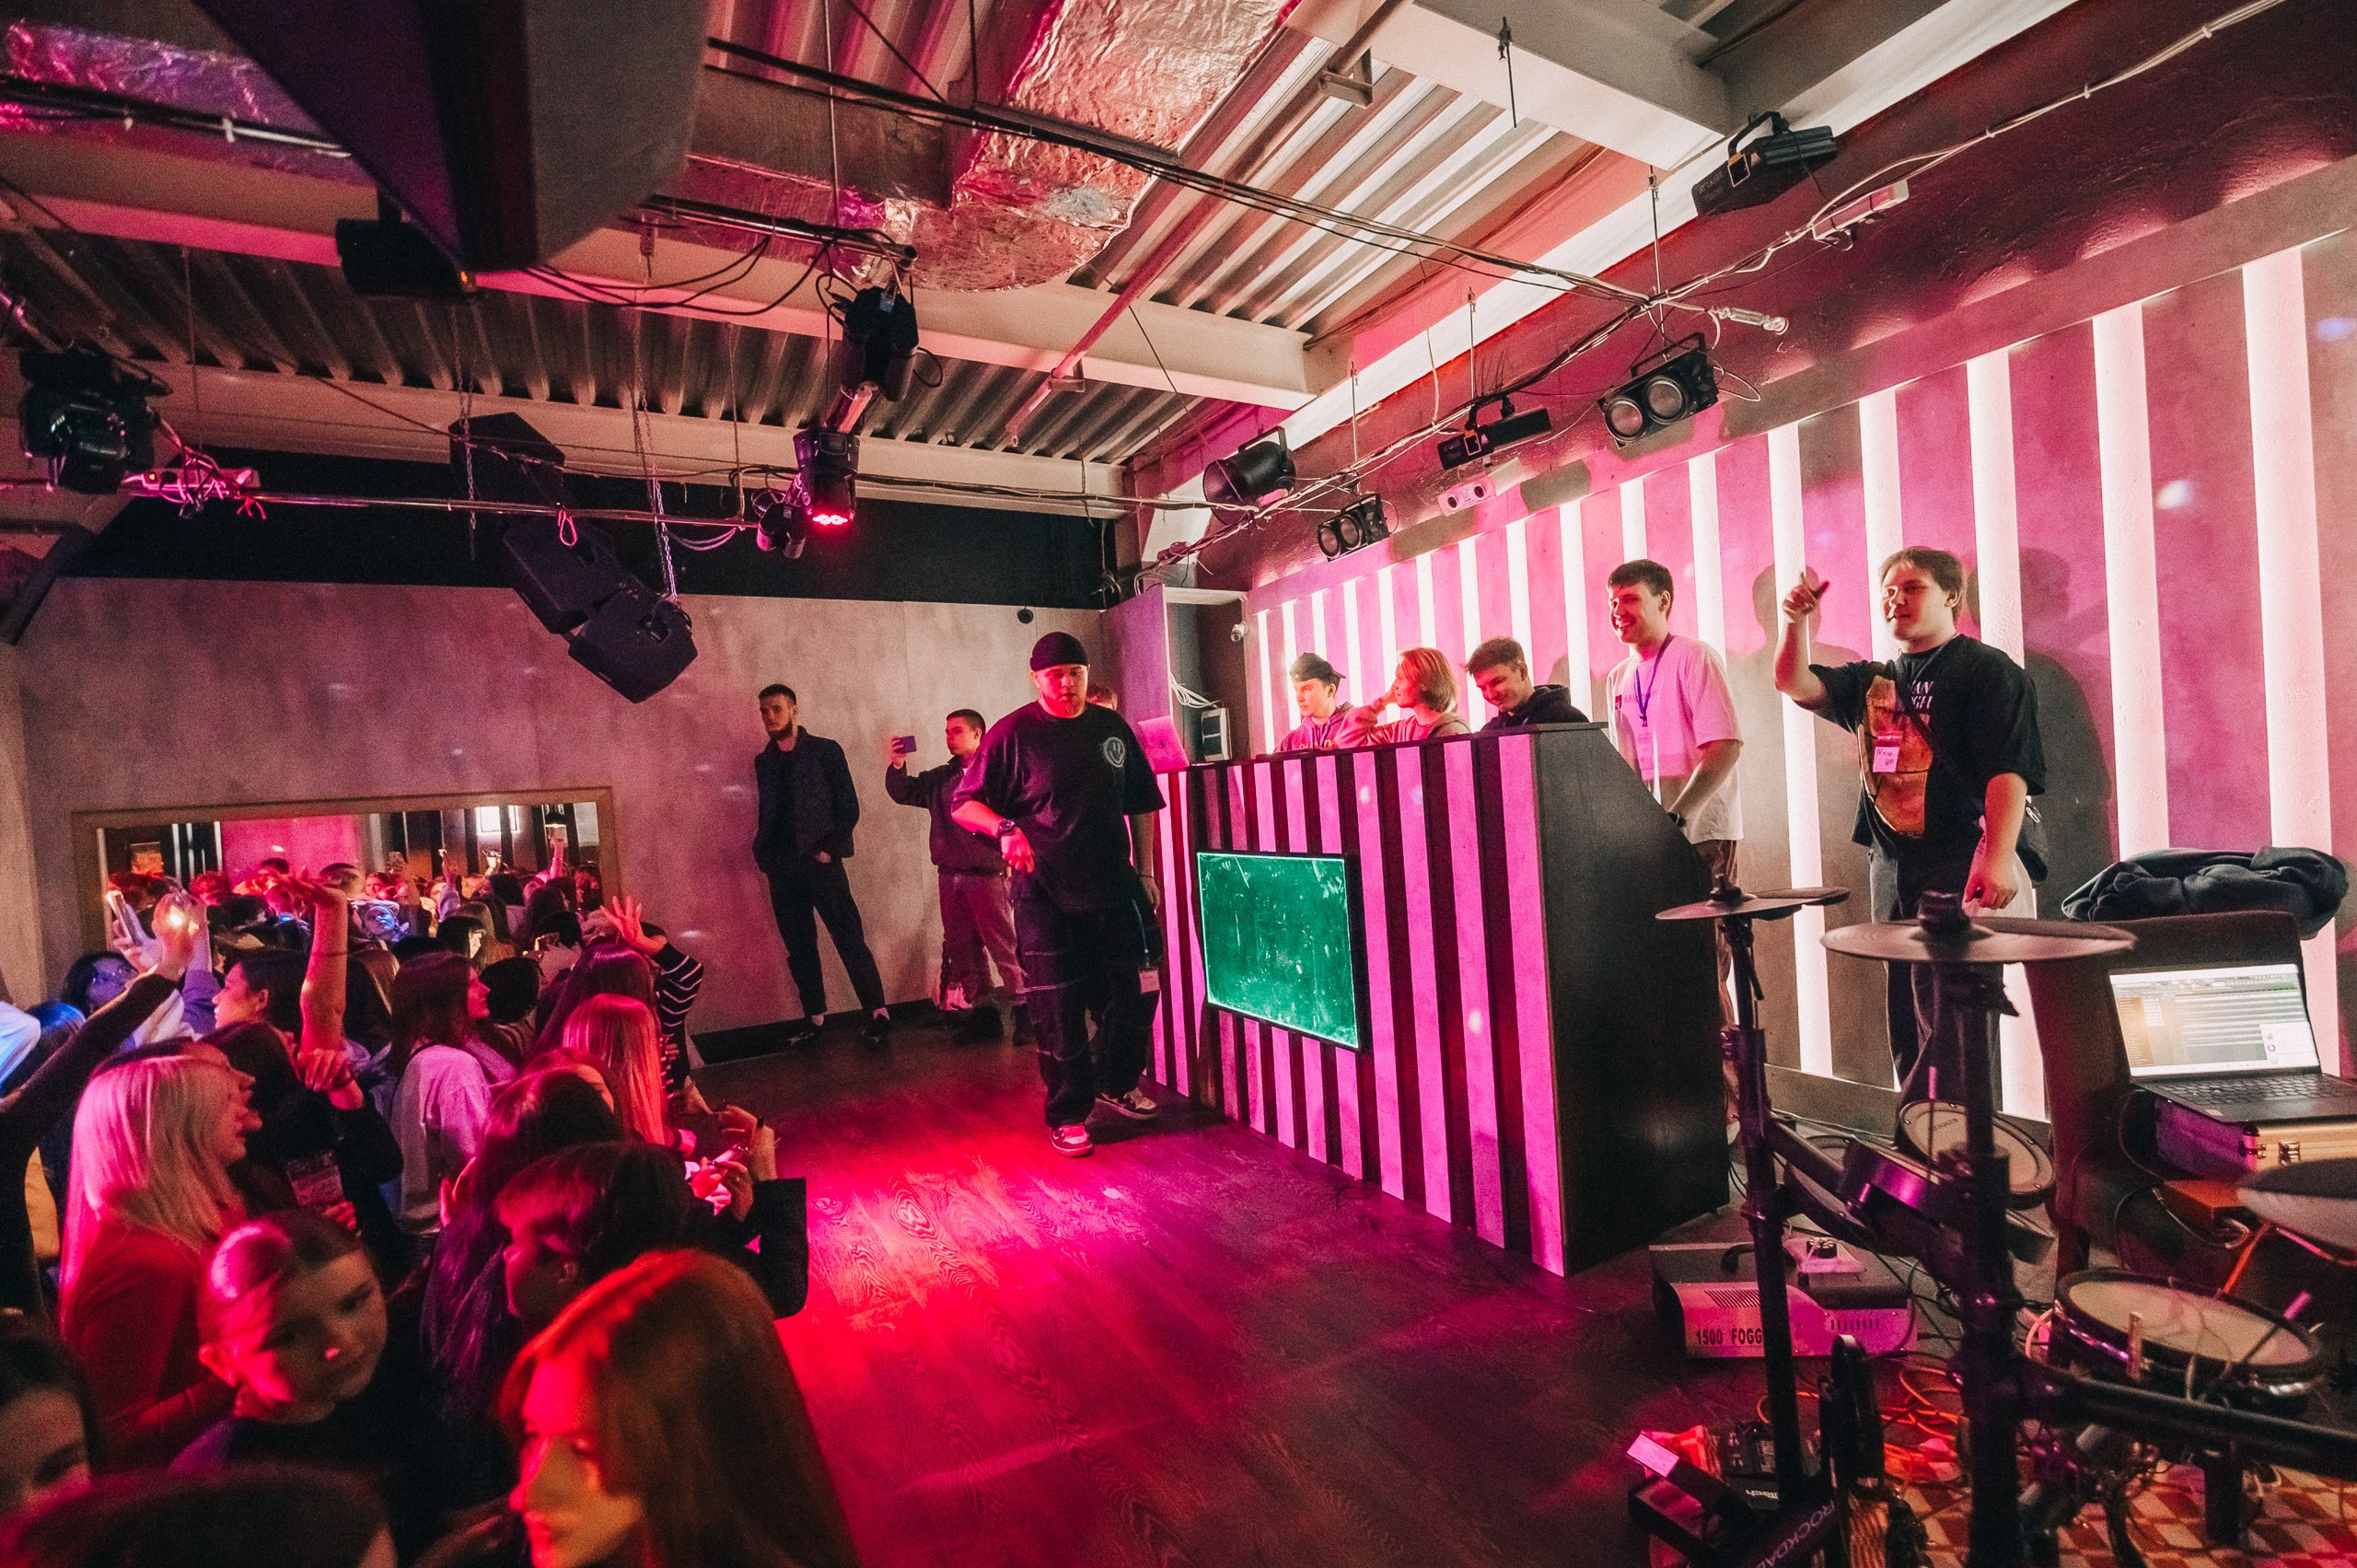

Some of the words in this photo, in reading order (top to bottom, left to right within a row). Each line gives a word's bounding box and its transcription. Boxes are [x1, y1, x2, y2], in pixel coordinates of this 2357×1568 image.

[1696, 1329, 1723, 1344] 1500
[1731, 1328, 1763, 1344] FOGG
[1756, 1498, 1835, 1568] ROCKDAL
